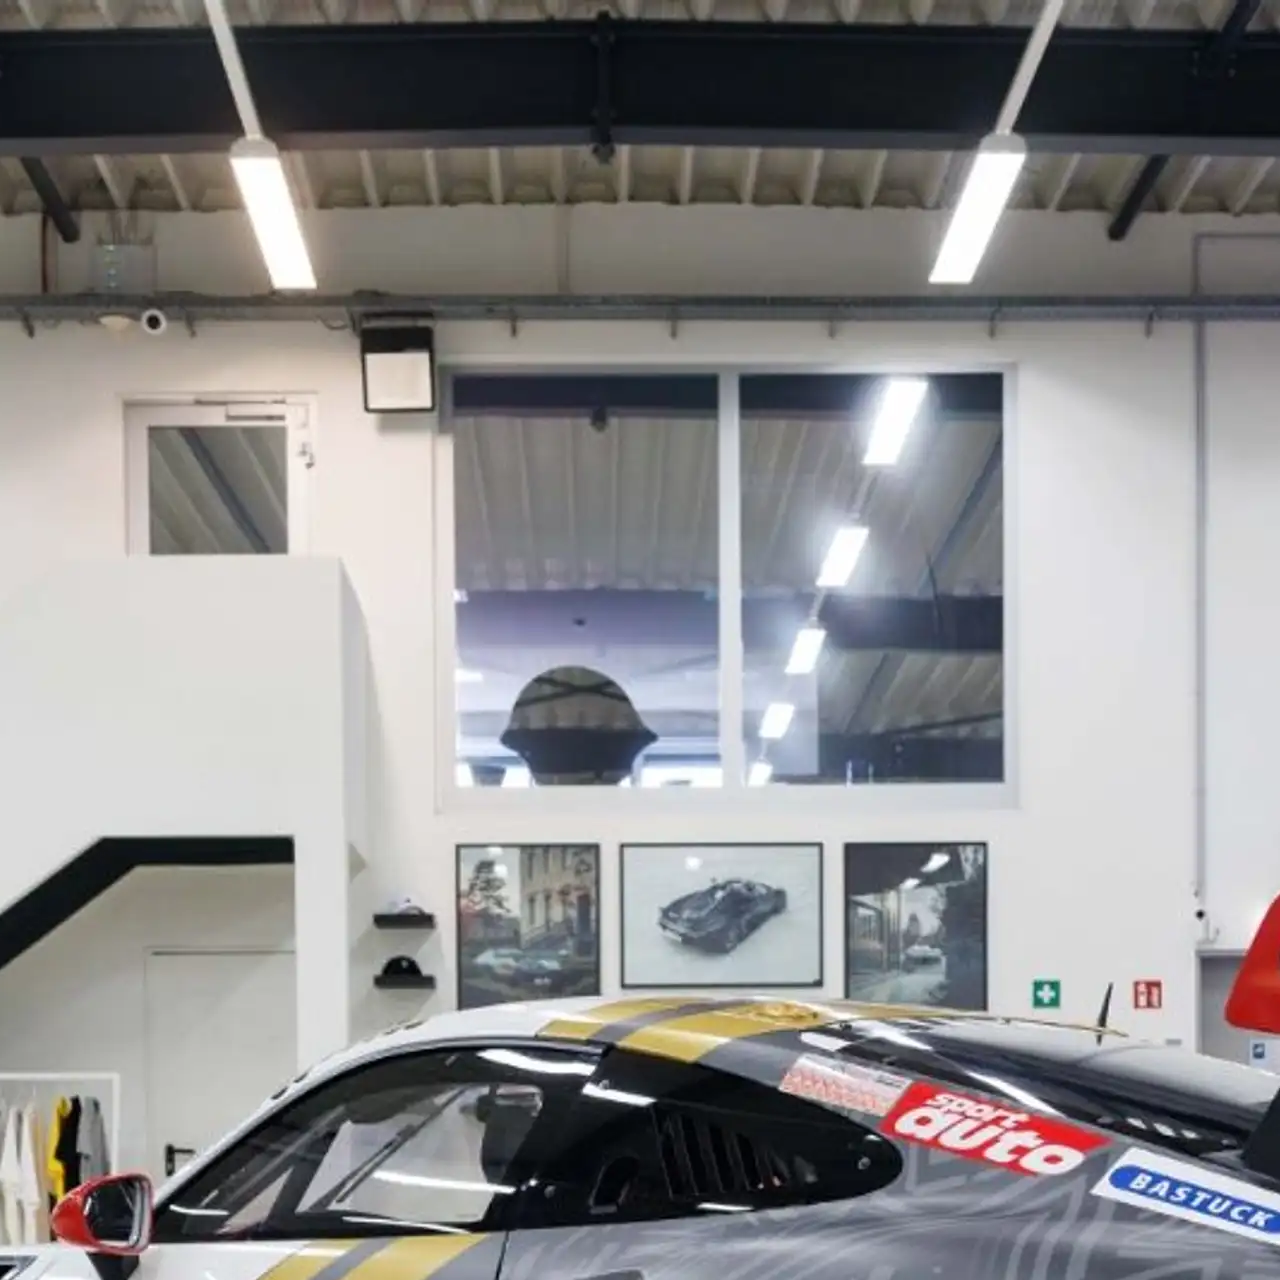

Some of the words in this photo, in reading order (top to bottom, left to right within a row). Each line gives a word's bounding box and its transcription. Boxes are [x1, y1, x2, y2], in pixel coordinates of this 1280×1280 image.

[926, 1093, 1030, 1128] sport
[894, 1107, 1086, 1175] auto
[1129, 1172, 1275, 1229] BASTUCK
